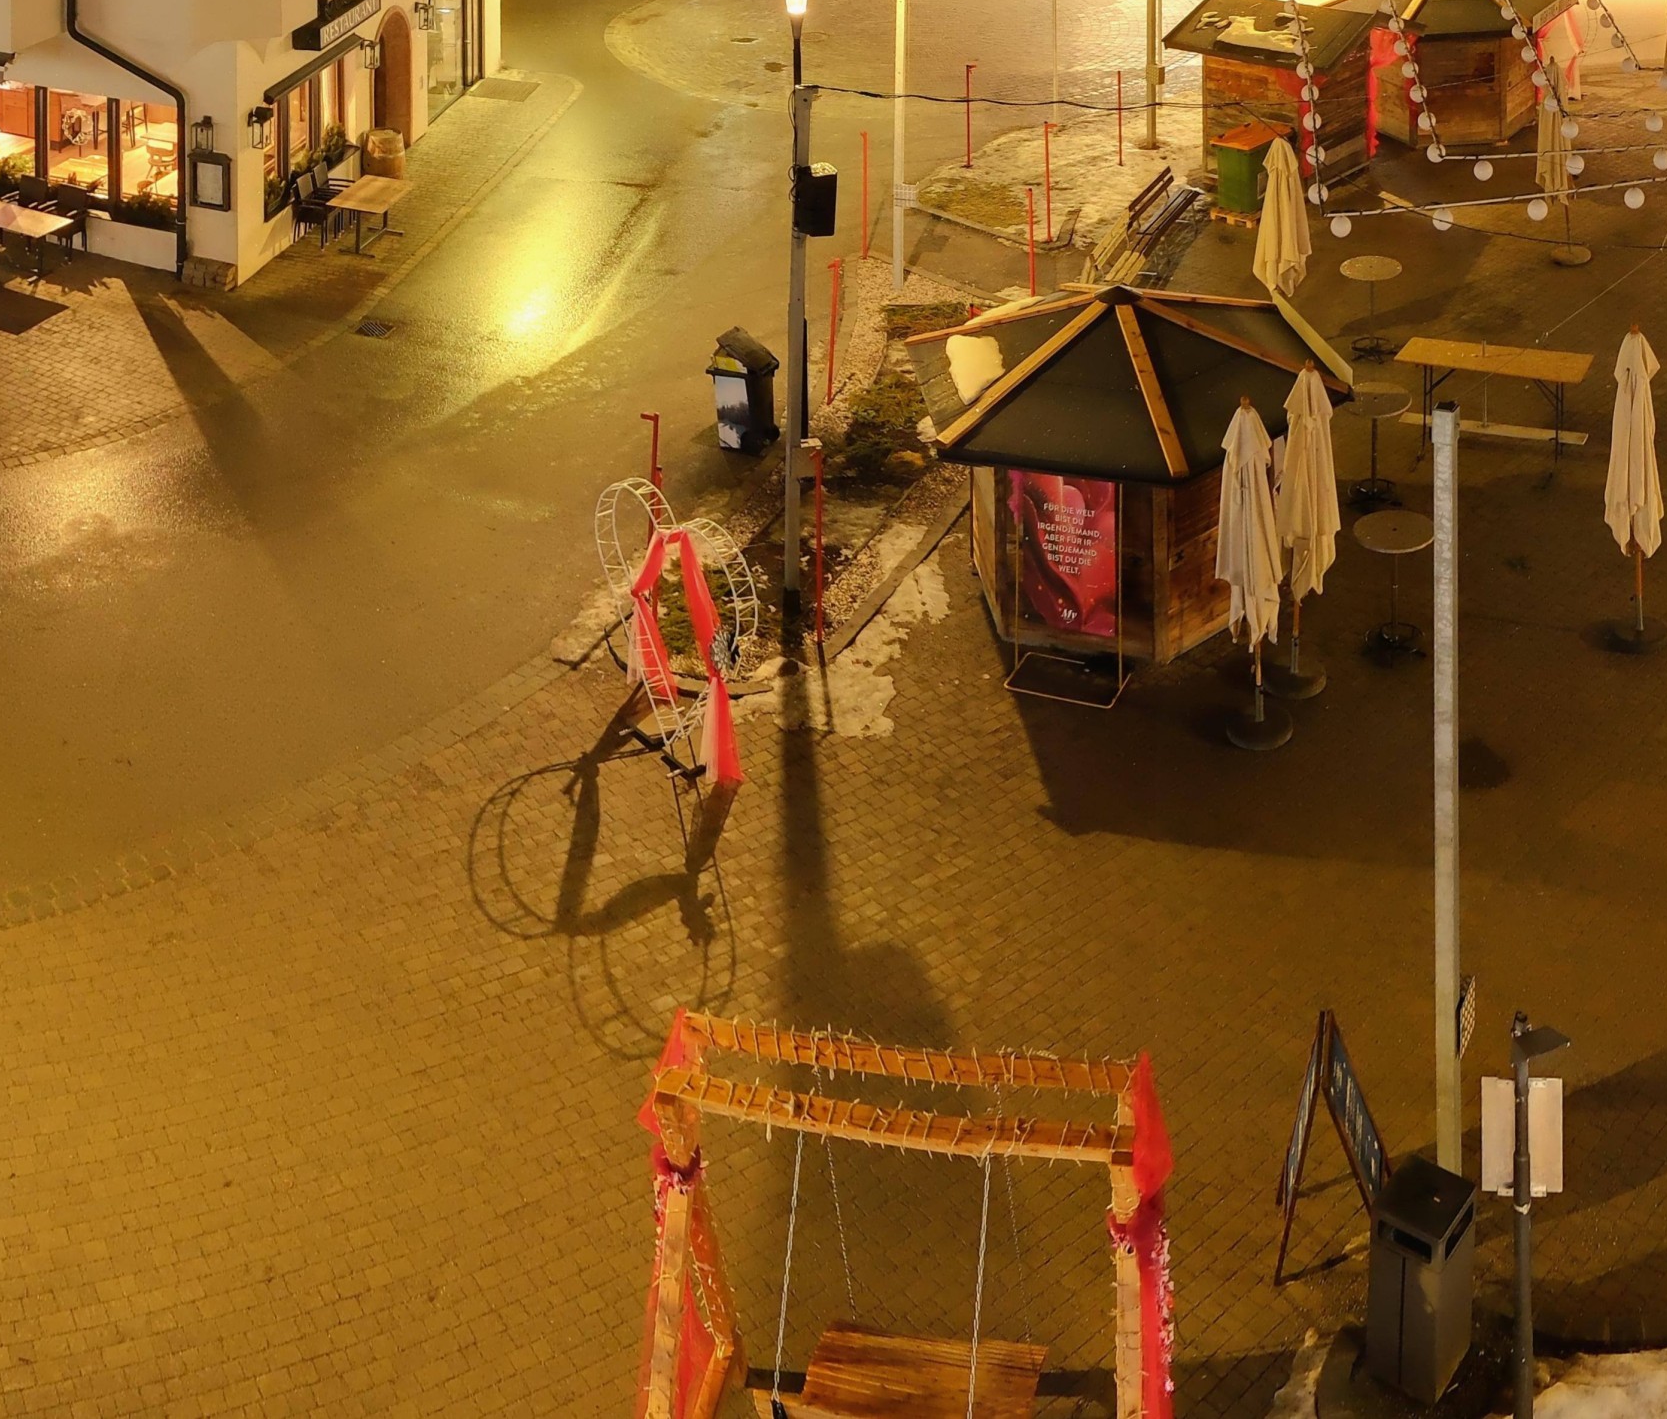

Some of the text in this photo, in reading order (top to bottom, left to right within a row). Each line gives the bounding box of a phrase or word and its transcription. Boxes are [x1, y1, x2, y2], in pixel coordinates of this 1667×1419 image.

[1043, 503, 1096, 518] FÜR DIE WELT
[1055, 514, 1084, 526] BIST DU
[1044, 533, 1065, 543] ABER
[1066, 535, 1082, 545] FÜR
[1042, 543, 1097, 557] GENDJEMAND
[1047, 553, 1092, 566] BIST DU DIE
